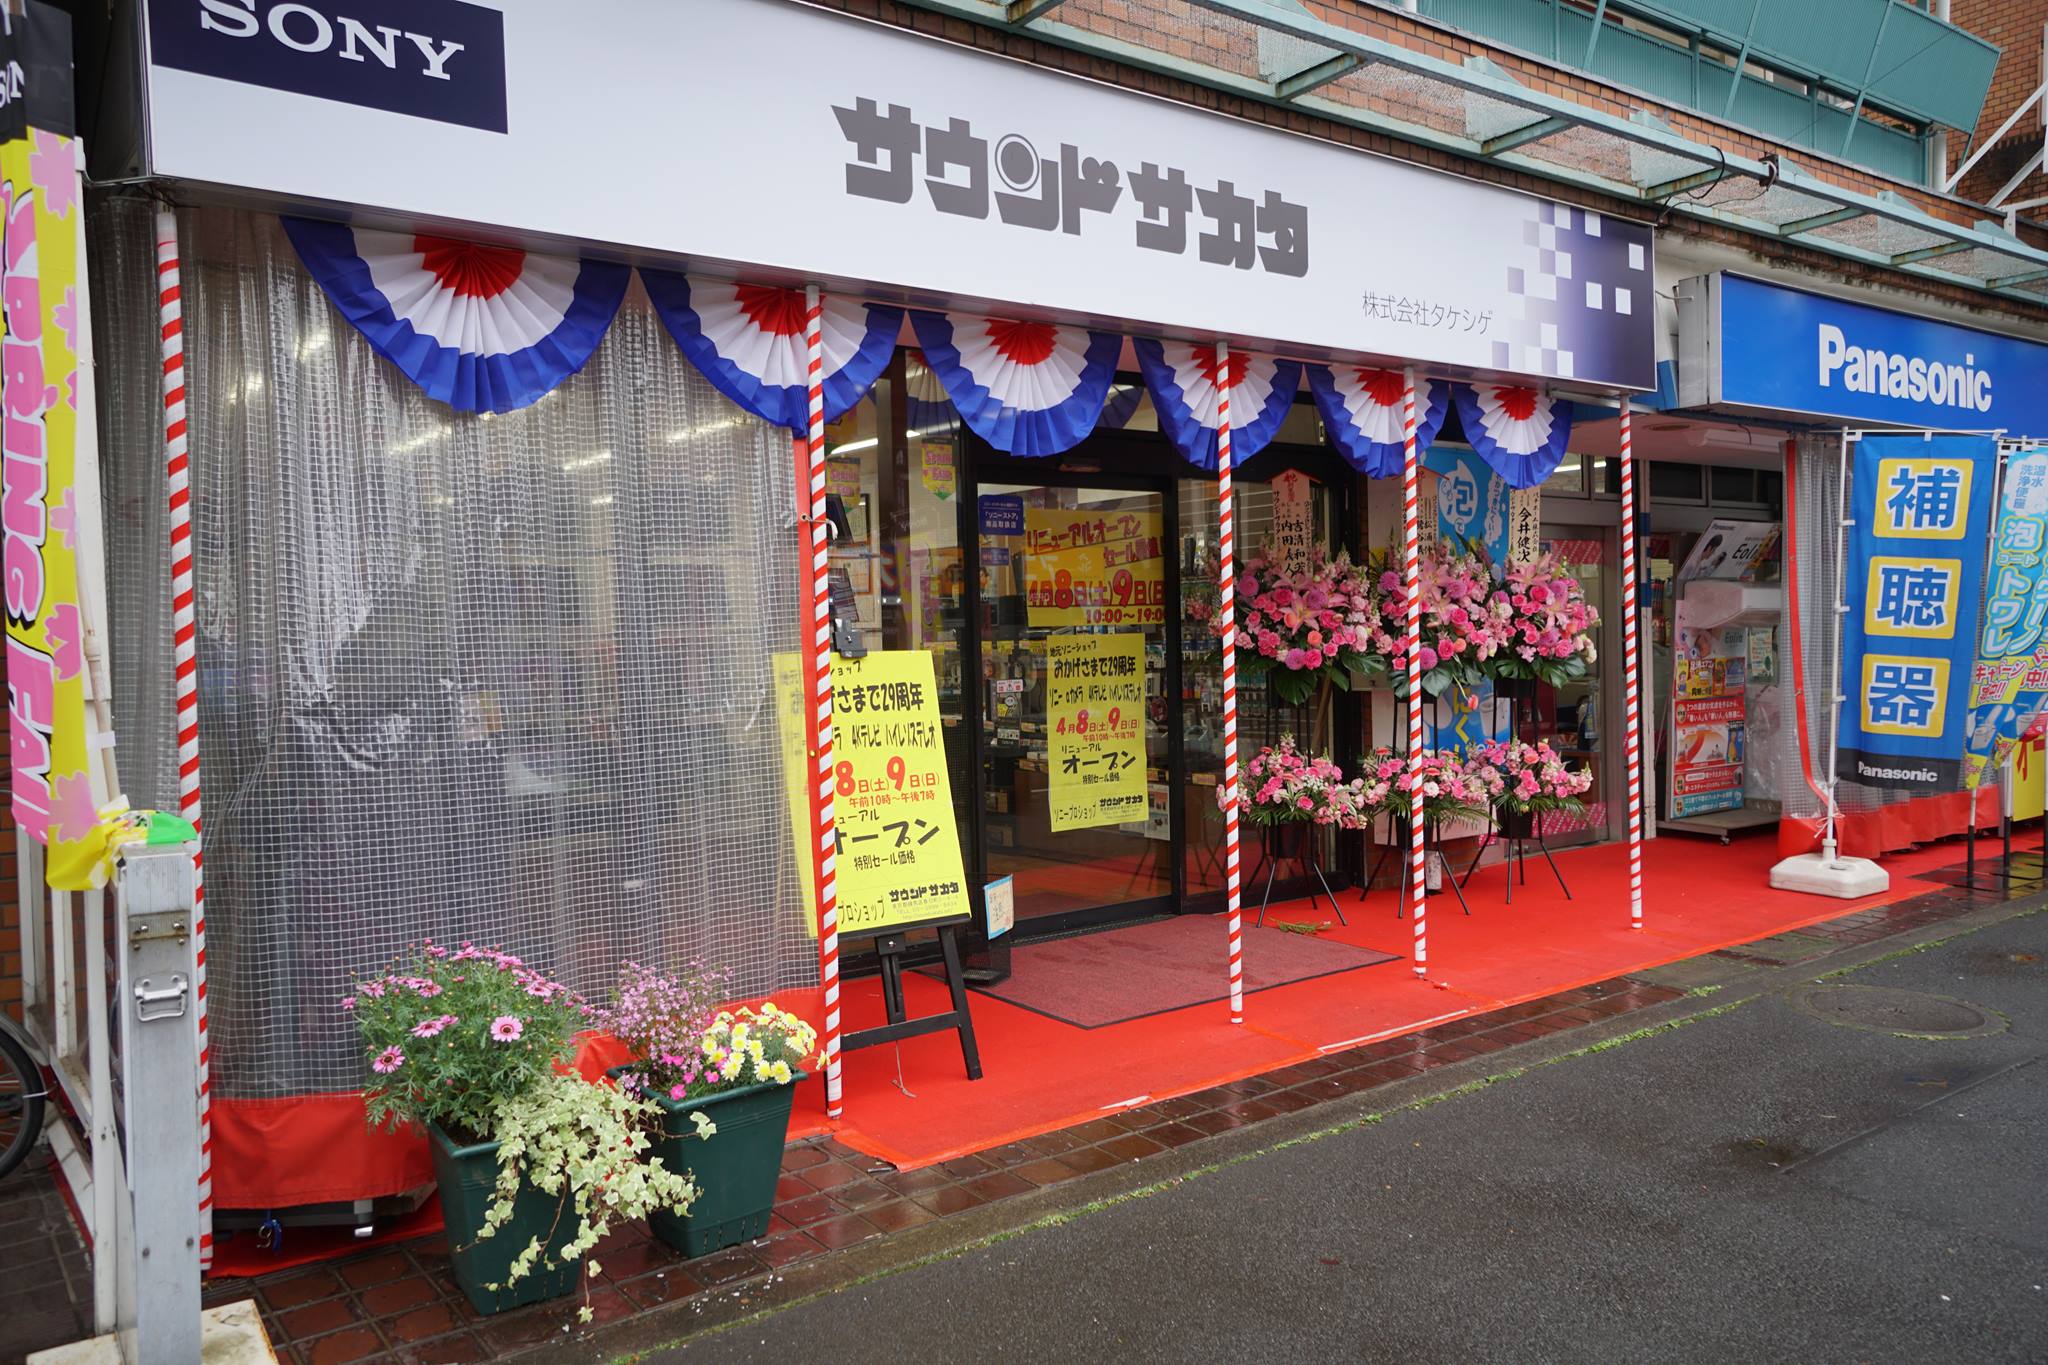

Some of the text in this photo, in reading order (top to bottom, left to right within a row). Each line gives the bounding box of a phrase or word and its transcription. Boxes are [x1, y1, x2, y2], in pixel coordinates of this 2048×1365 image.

[200, 0, 465, 81] SONY
[831, 96, 1309, 278] サウンドサカタ
[1362, 290, 1493, 335] 株式会社タケシゲ
[1819, 323, 1992, 412] Panasonic
[2031, 464, 2046, 487] 温水
[1516, 507, 1532, 563] 今井健次
[2003, 520, 2038, 548] 泡
[1998, 553, 2037, 566] コート
[1868, 466, 1961, 727] 補聴器
[1087, 608, 1165, 624] 10:00～19:0
[1986, 570, 2027, 653] トワレ
[1050, 640, 1098, 657] 地元ソニーショップ
[831, 660, 862, 677] ョップ
[1054, 656, 1136, 679] おかげさまで29周年
[851, 722, 882, 750] 4Kテレビ
[1061, 743, 1102, 754] リニューアル
[1062, 750, 1137, 775] オープン
[1858, 761, 1938, 783] Panasonic
[834, 808, 880, 825] ューアル
[1054, 801, 1097, 823] ソニープロショップ
[854, 850, 916, 871] 特別セール価格
